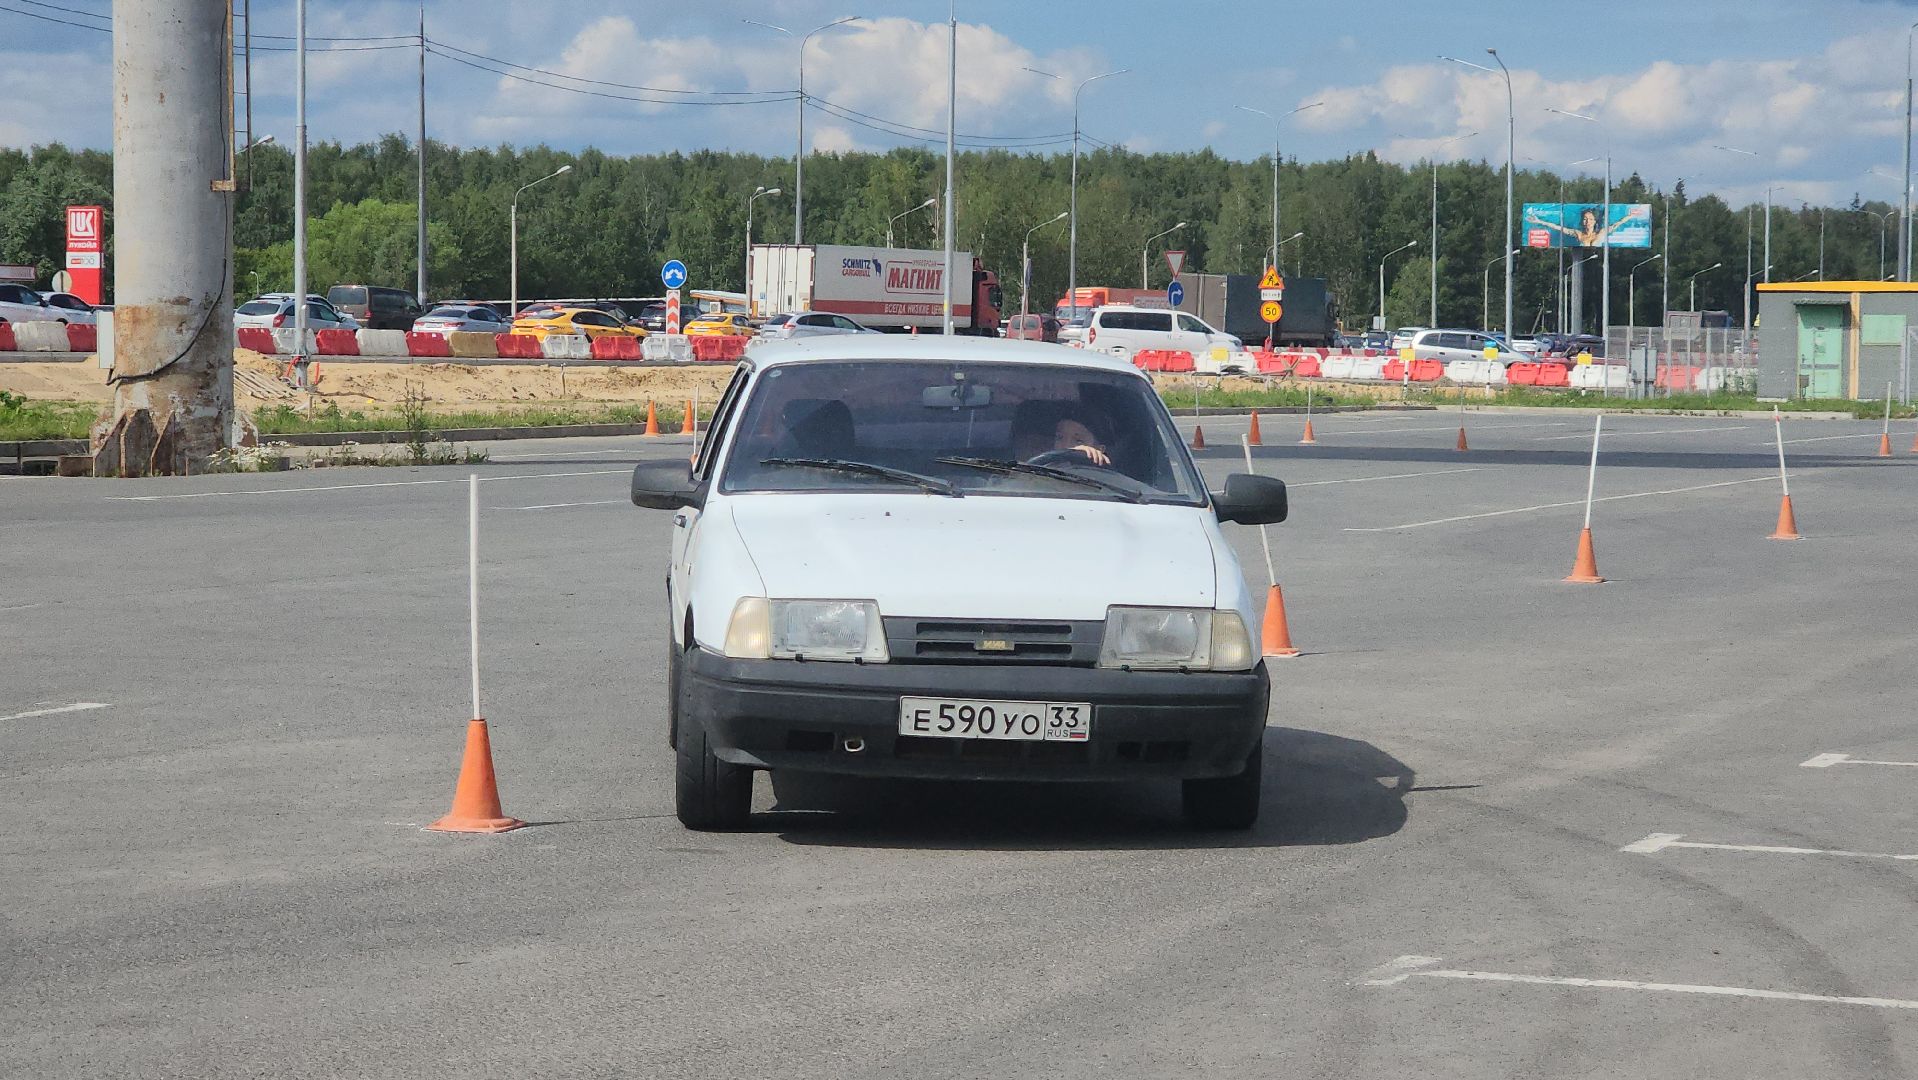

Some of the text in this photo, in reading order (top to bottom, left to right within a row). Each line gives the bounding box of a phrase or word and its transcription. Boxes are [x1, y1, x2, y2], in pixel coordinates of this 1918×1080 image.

[842, 258, 871, 269] SCHMITZ
[887, 267, 944, 290] МАГНИТ
[1265, 307, 1277, 316] 50
[1050, 706, 1080, 728] 33
[1047, 729, 1069, 738] RUS
